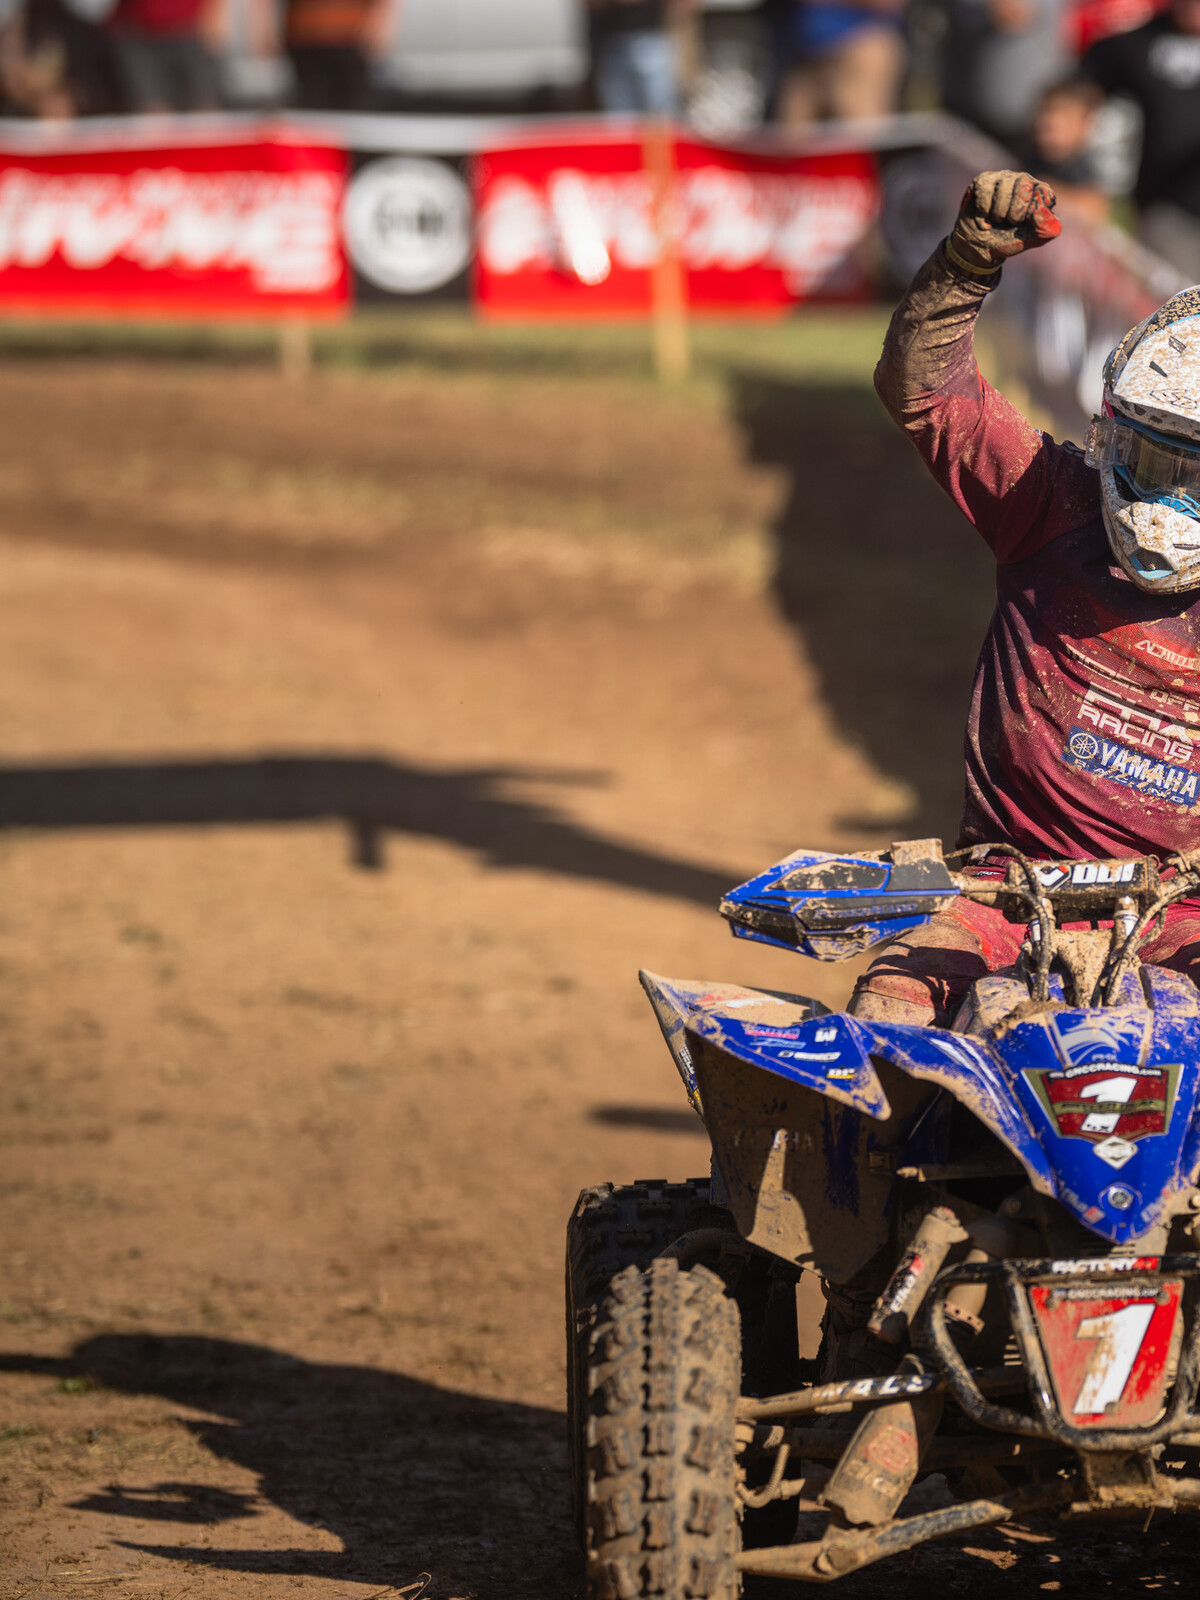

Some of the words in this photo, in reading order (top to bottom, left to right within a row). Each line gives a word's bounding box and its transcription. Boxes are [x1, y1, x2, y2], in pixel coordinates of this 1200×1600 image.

[1076, 703, 1194, 761] RACING
[1100, 742, 1199, 798] YAMAHA
[1080, 1076, 1138, 1134] 1
[1073, 1303, 1157, 1415] 1
